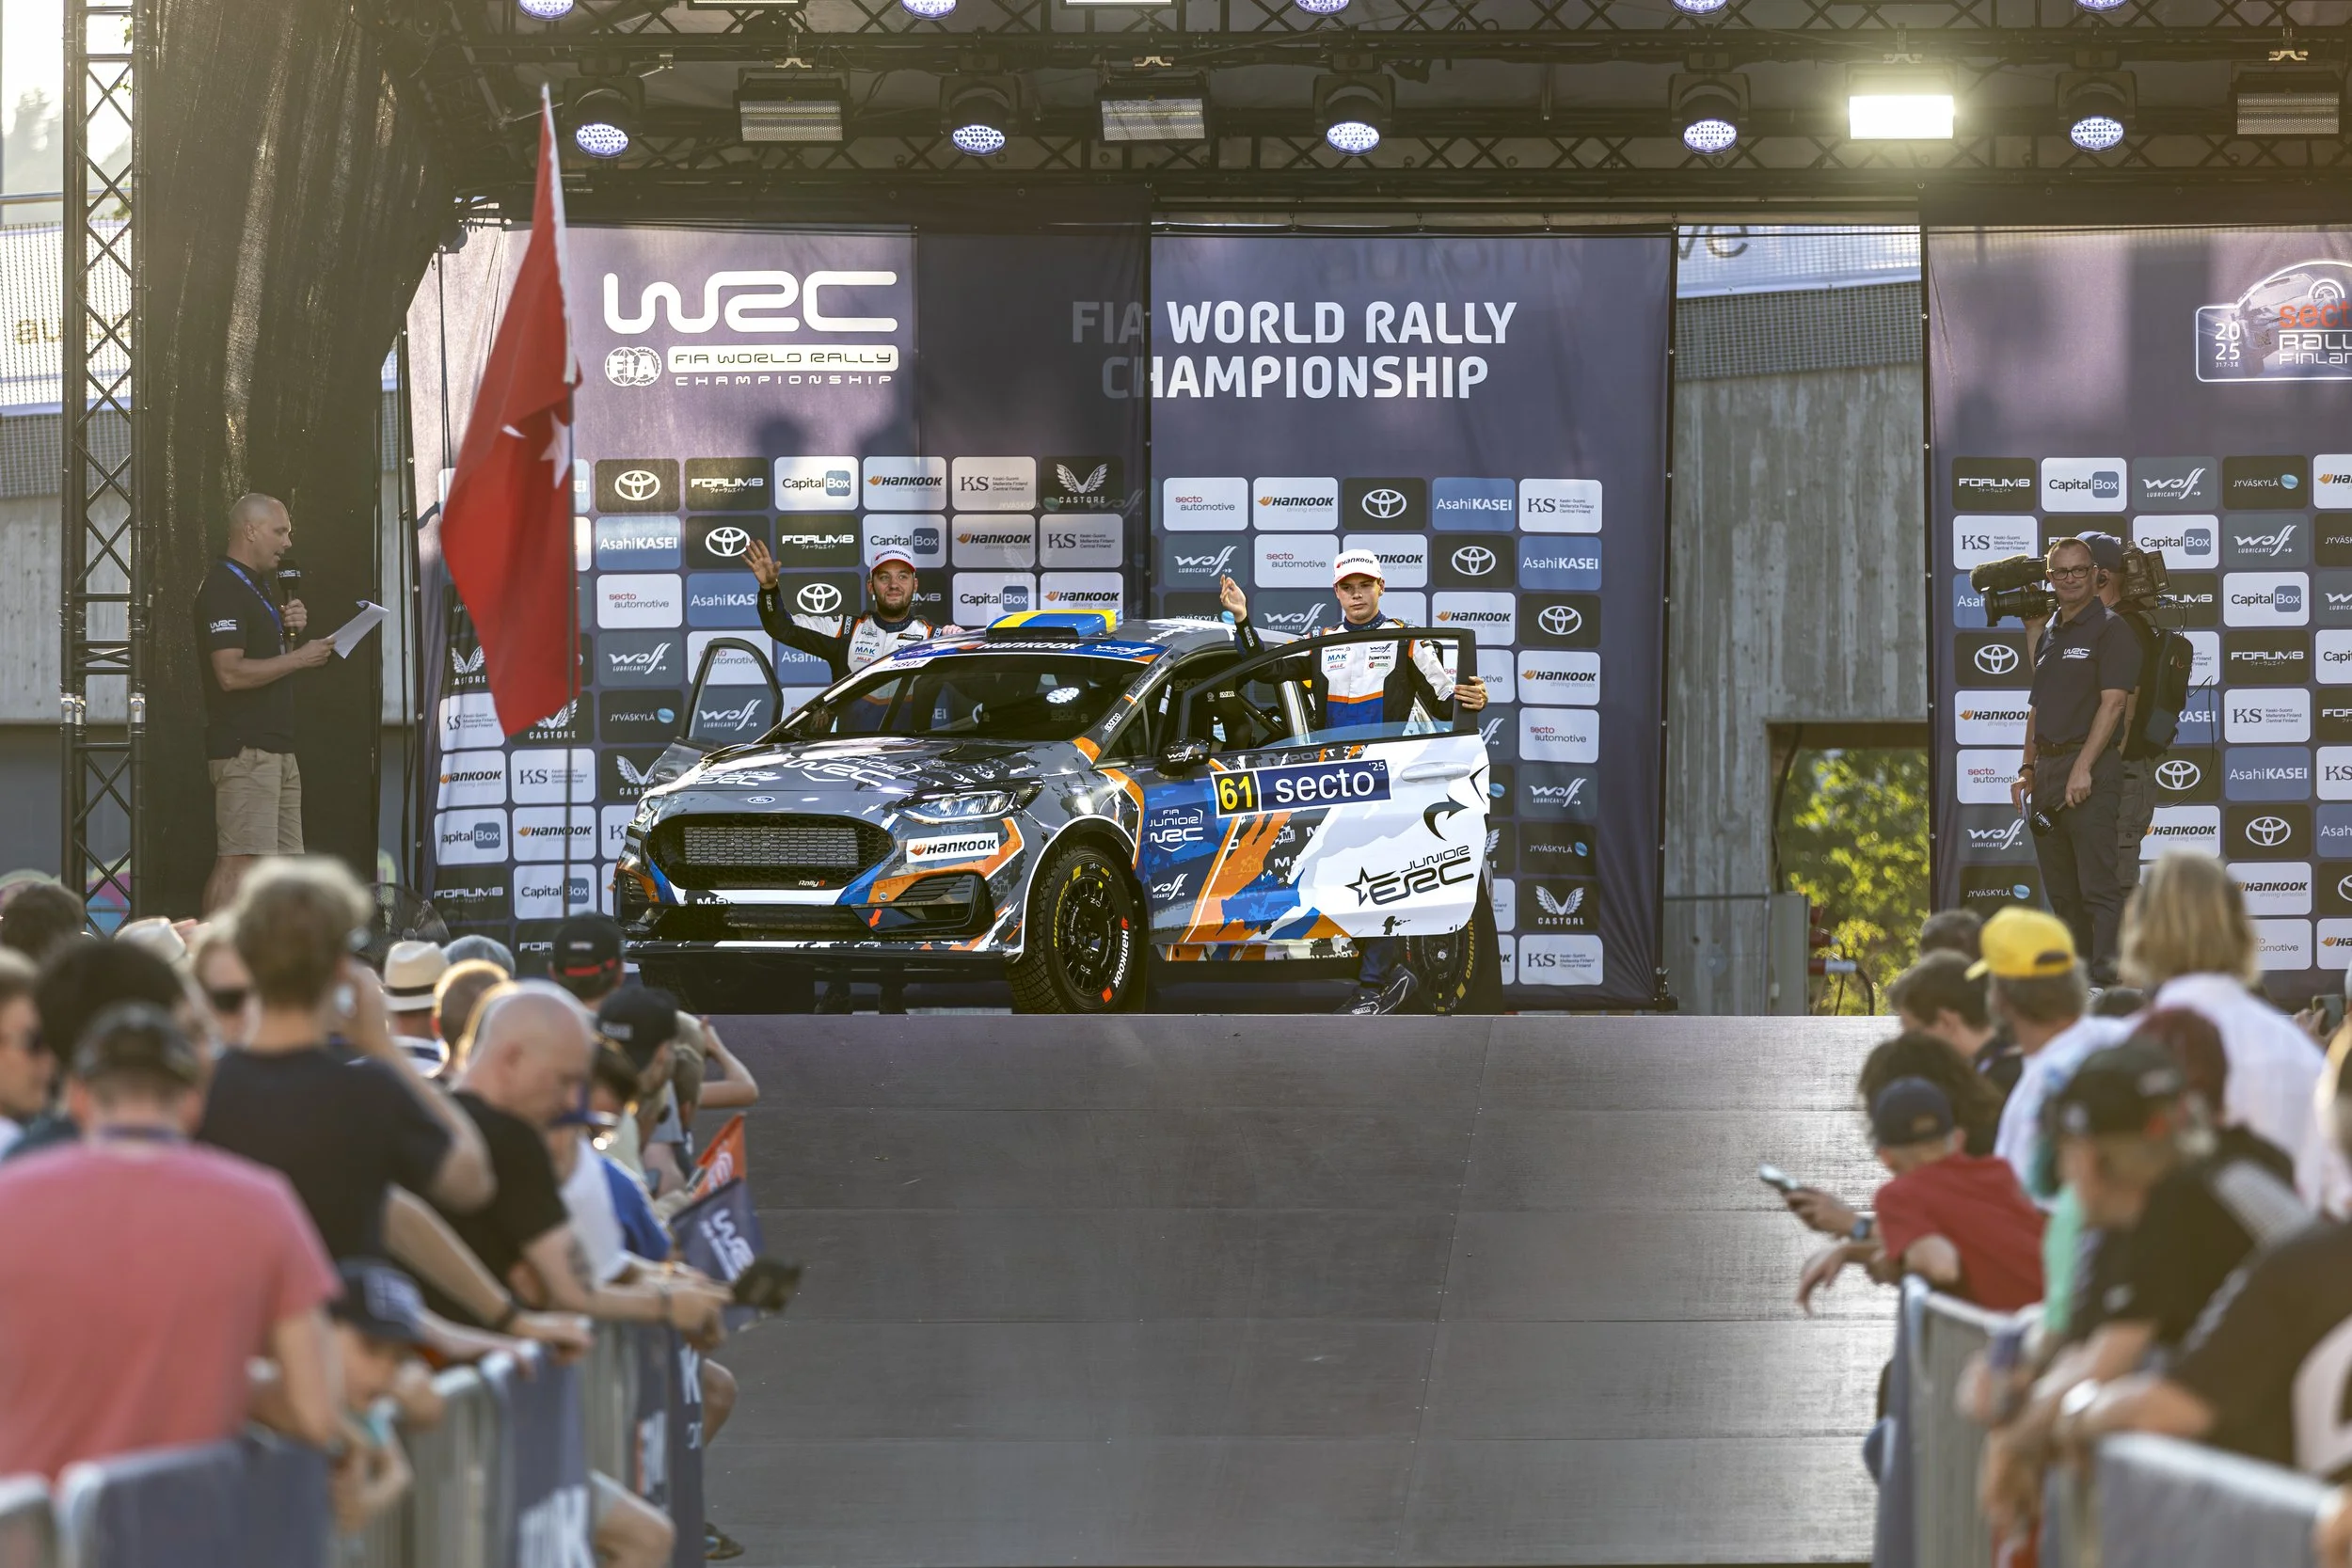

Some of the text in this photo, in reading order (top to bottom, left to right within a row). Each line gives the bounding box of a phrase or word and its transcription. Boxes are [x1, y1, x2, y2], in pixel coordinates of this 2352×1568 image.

[603, 270, 898, 334] WRC
[1072, 301, 1517, 343] FIA WORLD RALLY
[2215, 324, 2240, 340] 20
[675, 354, 891, 364] FIA WORLD RALLY
[2215, 343, 2240, 360] 25
[675, 375, 892, 386] CHAMPIONSHIP
[1102, 356, 1488, 399] CHAMPIONSHIP
[691, 478, 764, 487] FORUM8
[961, 476, 989, 491] KS
[1959, 478, 2030, 487] FORUM8
[1528, 499, 1556, 513] KS
[782, 534, 854, 544] FORUM8
[1048, 533, 1076, 548] KS
[1962, 534, 1990, 550] KS
[1272, 560, 1327, 568] automotive
[614, 600, 669, 609] automotive
[2231, 651, 2303, 660] FORUM8
[2233, 708, 2262, 723] KS
[1535, 735, 1586, 743] automotive
[519, 769, 548, 784] KS
[1219, 775, 1253, 810] 61
[1276, 768, 1375, 802] secto
[1150, 817, 1199, 827] JUNIOR
[1401, 845, 1470, 873] JUNIOR
[1369, 857, 1474, 905] ERC
[1528, 954, 1555, 967] KS
